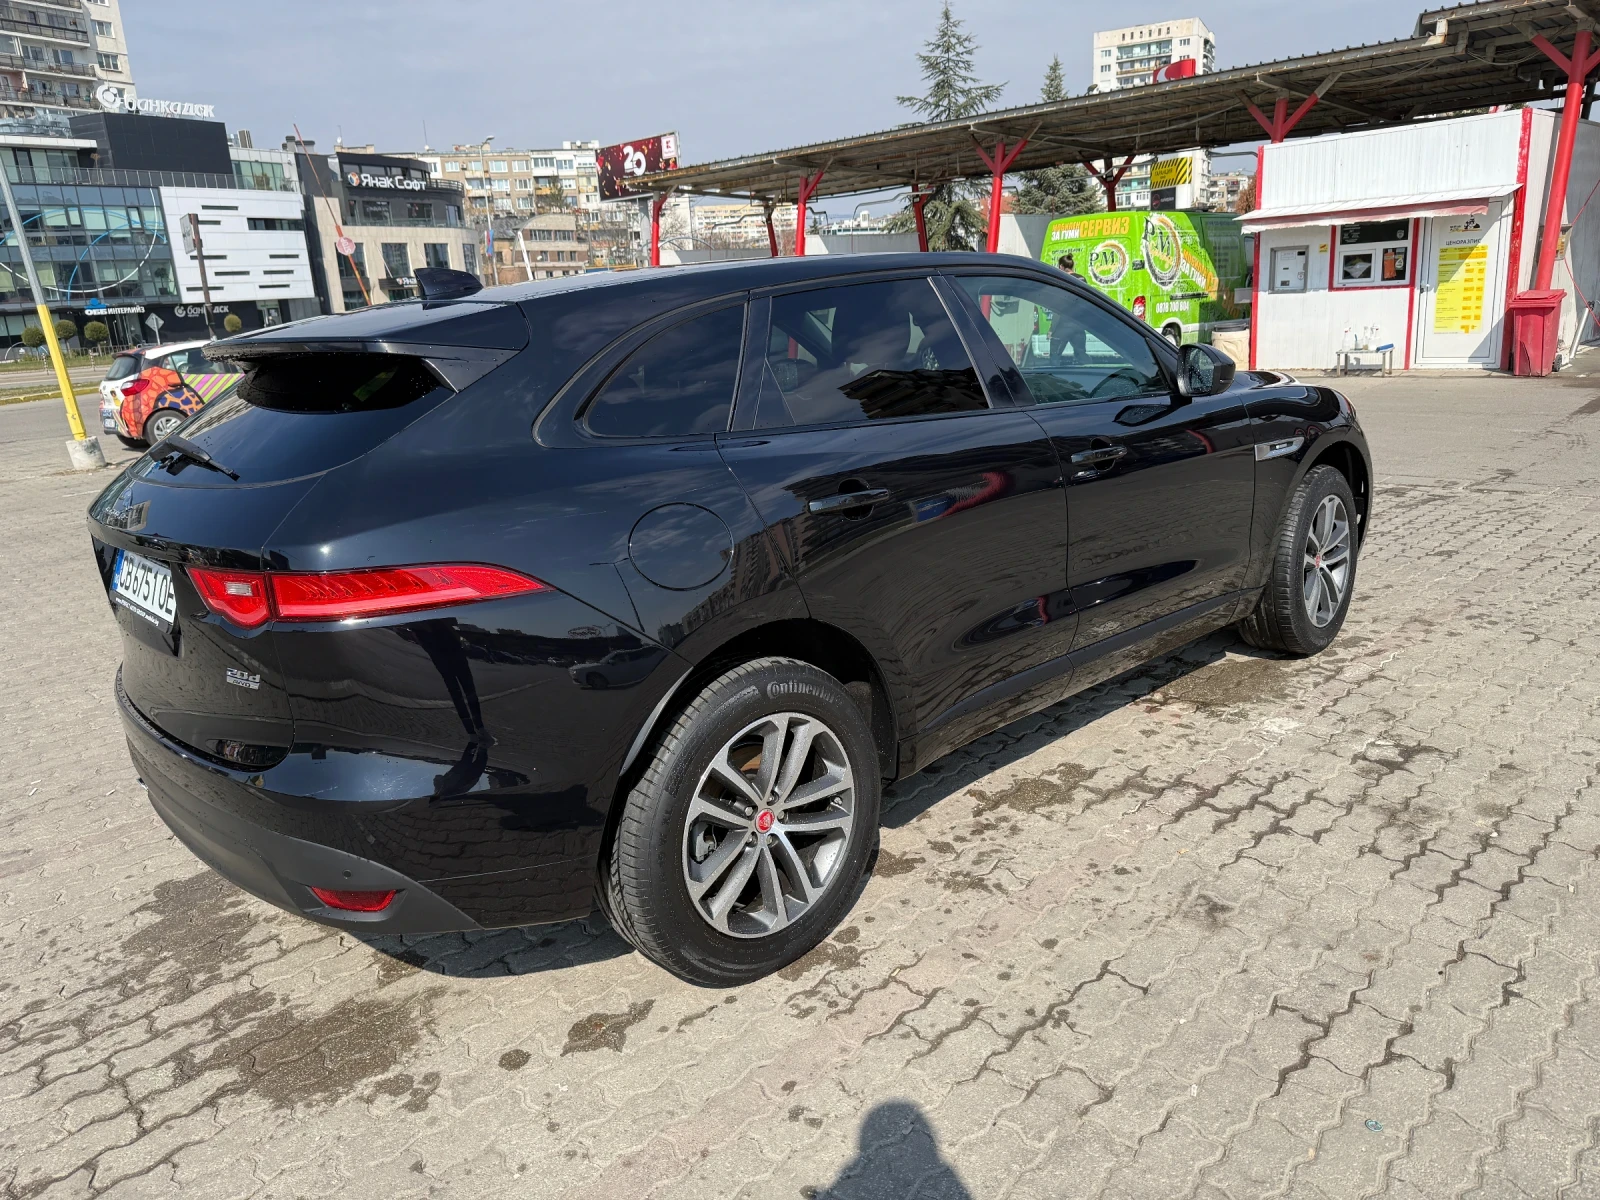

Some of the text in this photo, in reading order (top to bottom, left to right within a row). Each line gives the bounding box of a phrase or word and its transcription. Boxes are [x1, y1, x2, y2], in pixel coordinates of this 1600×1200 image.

[623, 145, 646, 176] 20
[361, 173, 427, 191] Янак Софт
[1051, 229, 1080, 241] ЗА ГУМИ
[1080, 216, 1130, 238] СЕРВИЗ
[1445, 238, 1481, 246] ЦЕНОРАЗПИС
[84, 308, 107, 316] ОББ
[766, 680, 837, 704] Continental
